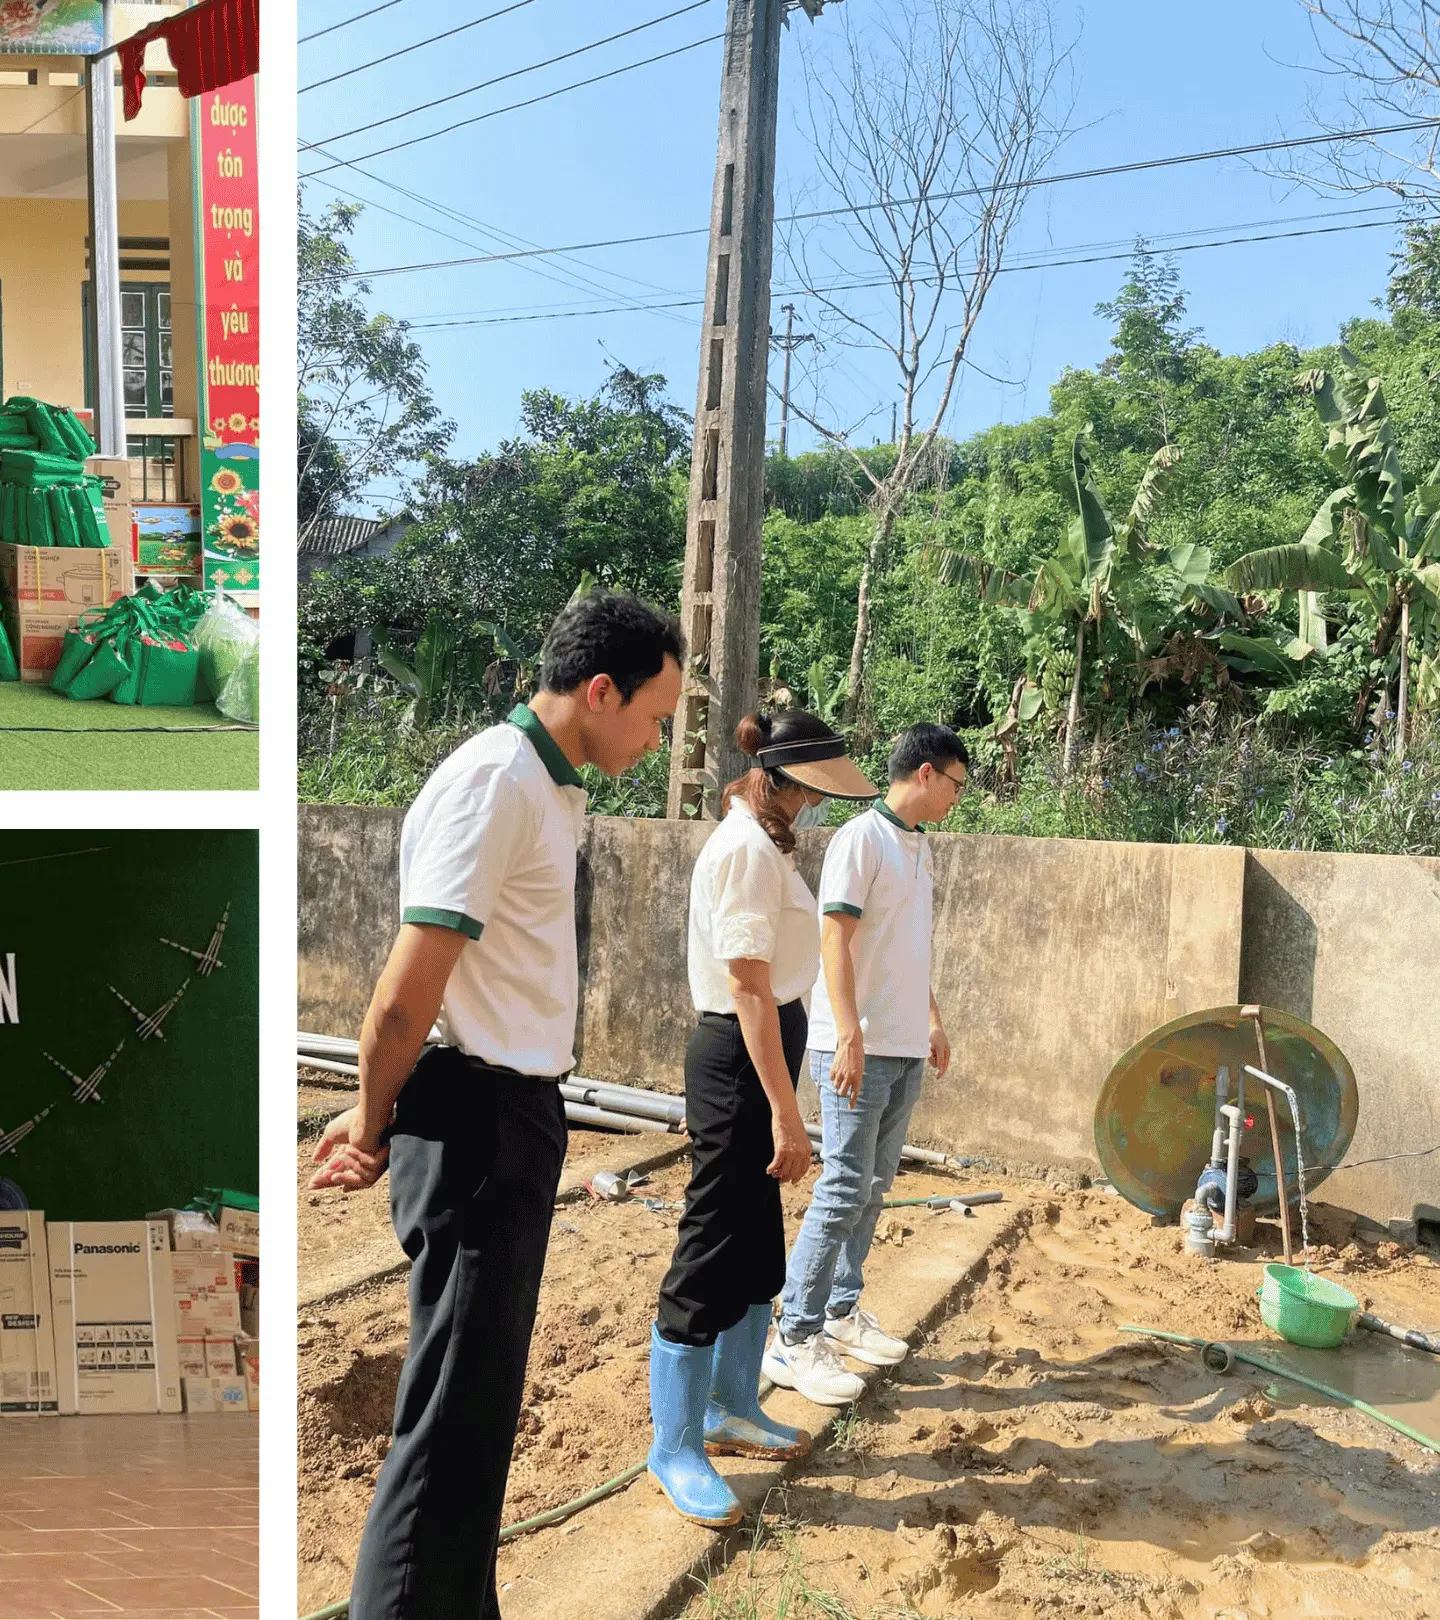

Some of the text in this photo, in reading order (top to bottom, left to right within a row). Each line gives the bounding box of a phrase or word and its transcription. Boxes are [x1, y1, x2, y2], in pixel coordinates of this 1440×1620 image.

[210, 94, 248, 136] được
[217, 148, 244, 178] tôn
[210, 203, 253, 239] trọng
[224, 251, 244, 282] và
[221, 303, 249, 340] yêu
[209, 355, 260, 393] thương
[73, 1242, 141, 1254] Panasonic
